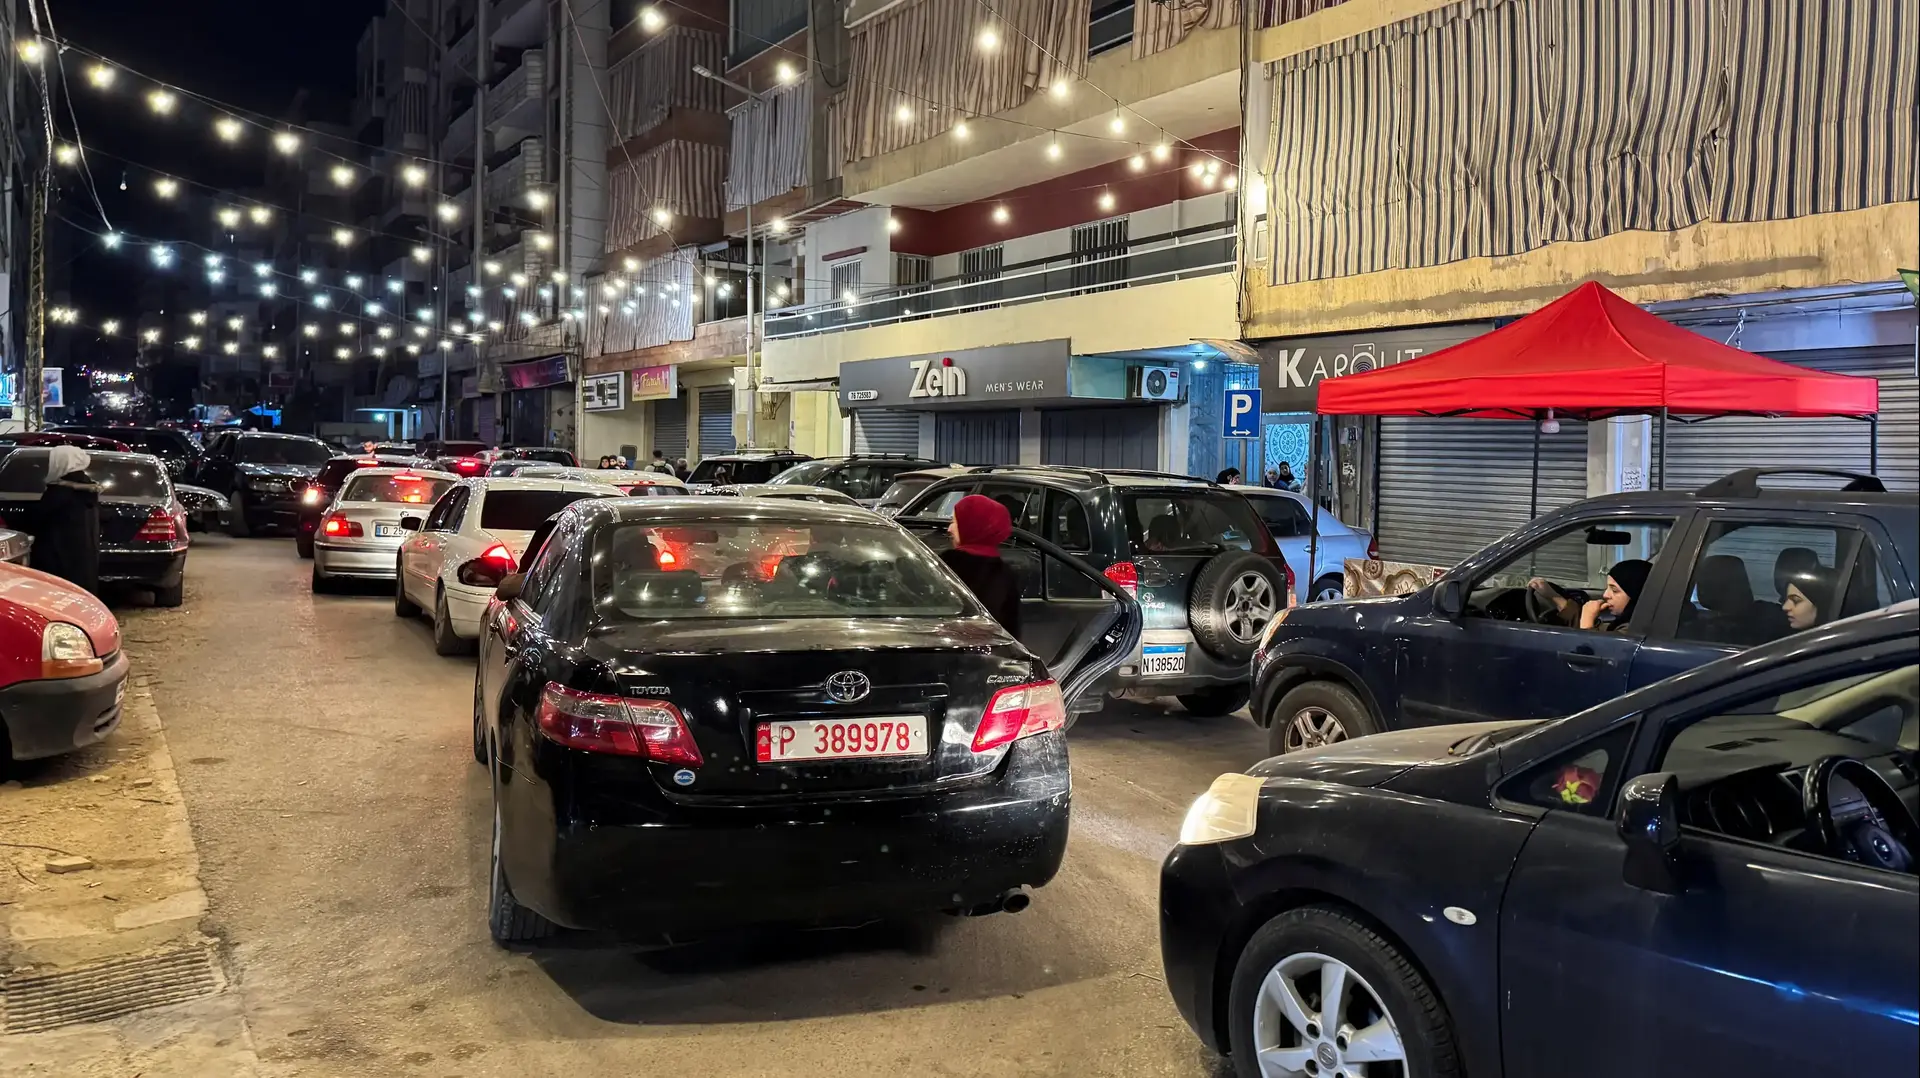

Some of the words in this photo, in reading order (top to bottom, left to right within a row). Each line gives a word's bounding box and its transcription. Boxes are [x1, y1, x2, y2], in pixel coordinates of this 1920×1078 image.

[908, 357, 966, 398] Zein
[985, 381, 1013, 393] MEN'S
[1016, 379, 1044, 391] WEAR
[1230, 393, 1253, 428] P
[630, 686, 671, 695] TOYOTA
[779, 725, 796, 755] P
[813, 722, 910, 754] 389978
